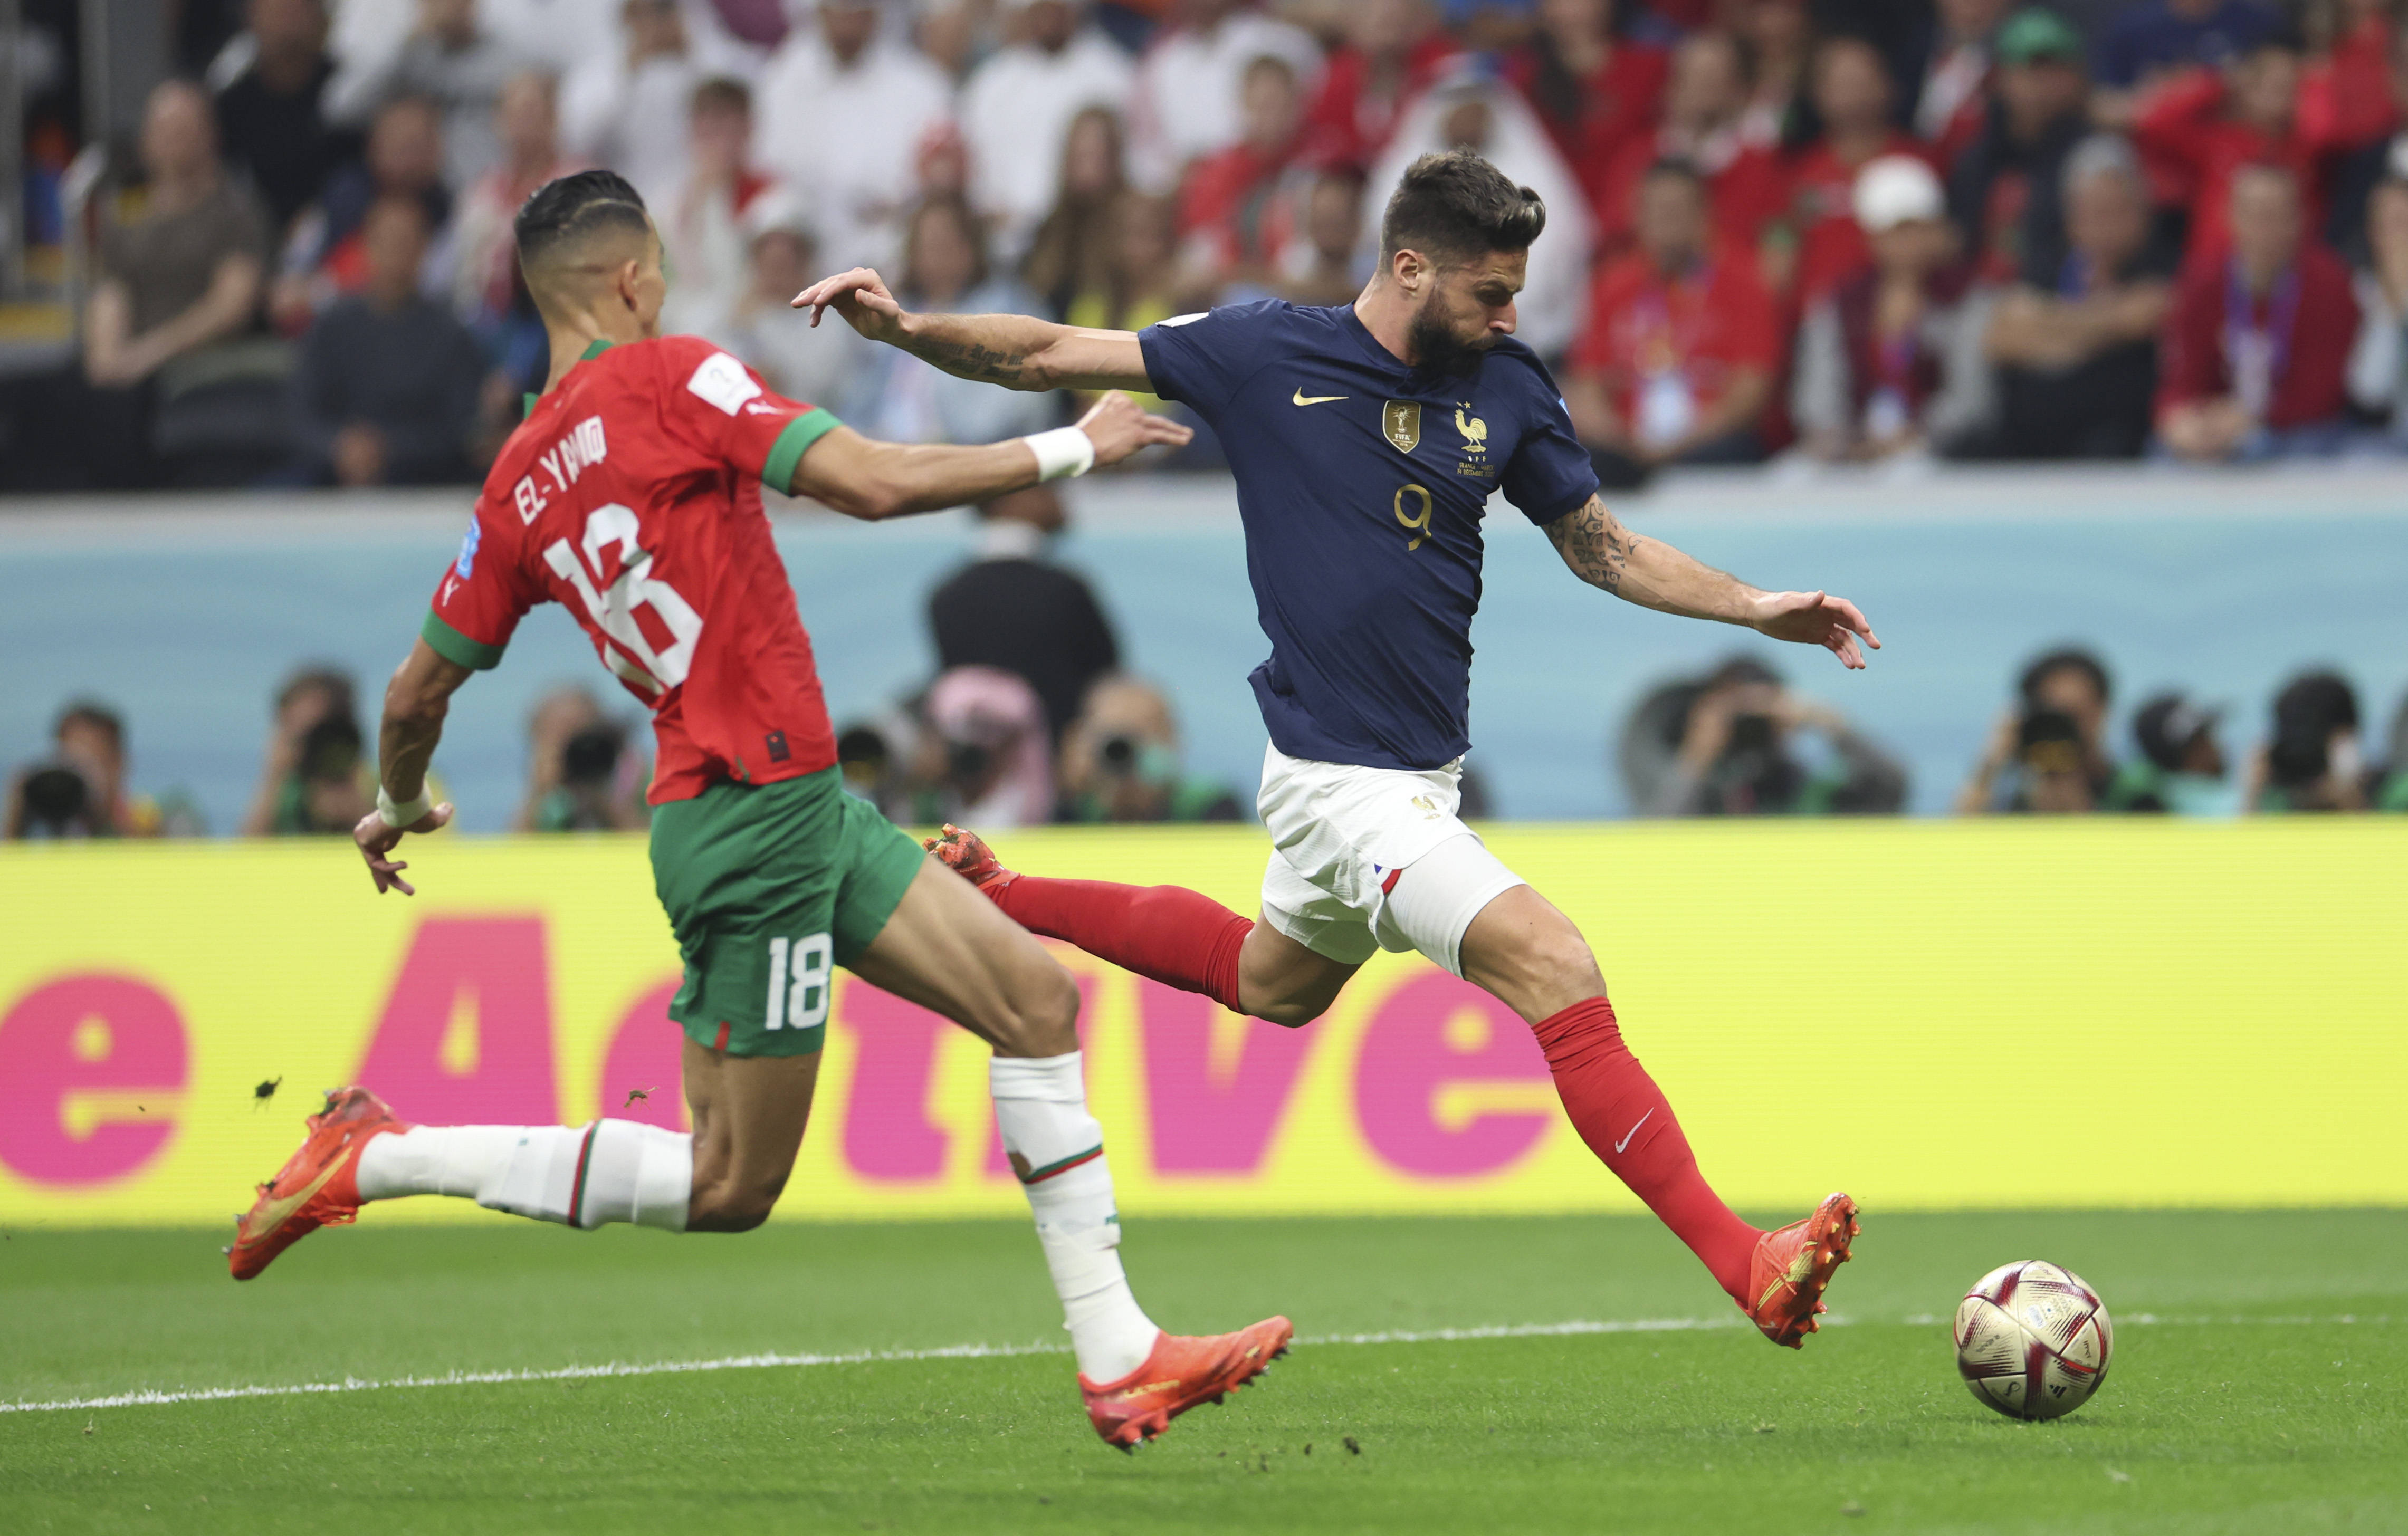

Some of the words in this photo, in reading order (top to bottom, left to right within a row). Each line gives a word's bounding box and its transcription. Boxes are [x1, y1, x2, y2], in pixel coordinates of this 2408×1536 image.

[1394, 483, 1432, 551] 9
[763, 931, 834, 1031] 18
[348, 914, 1559, 1187] Atve
